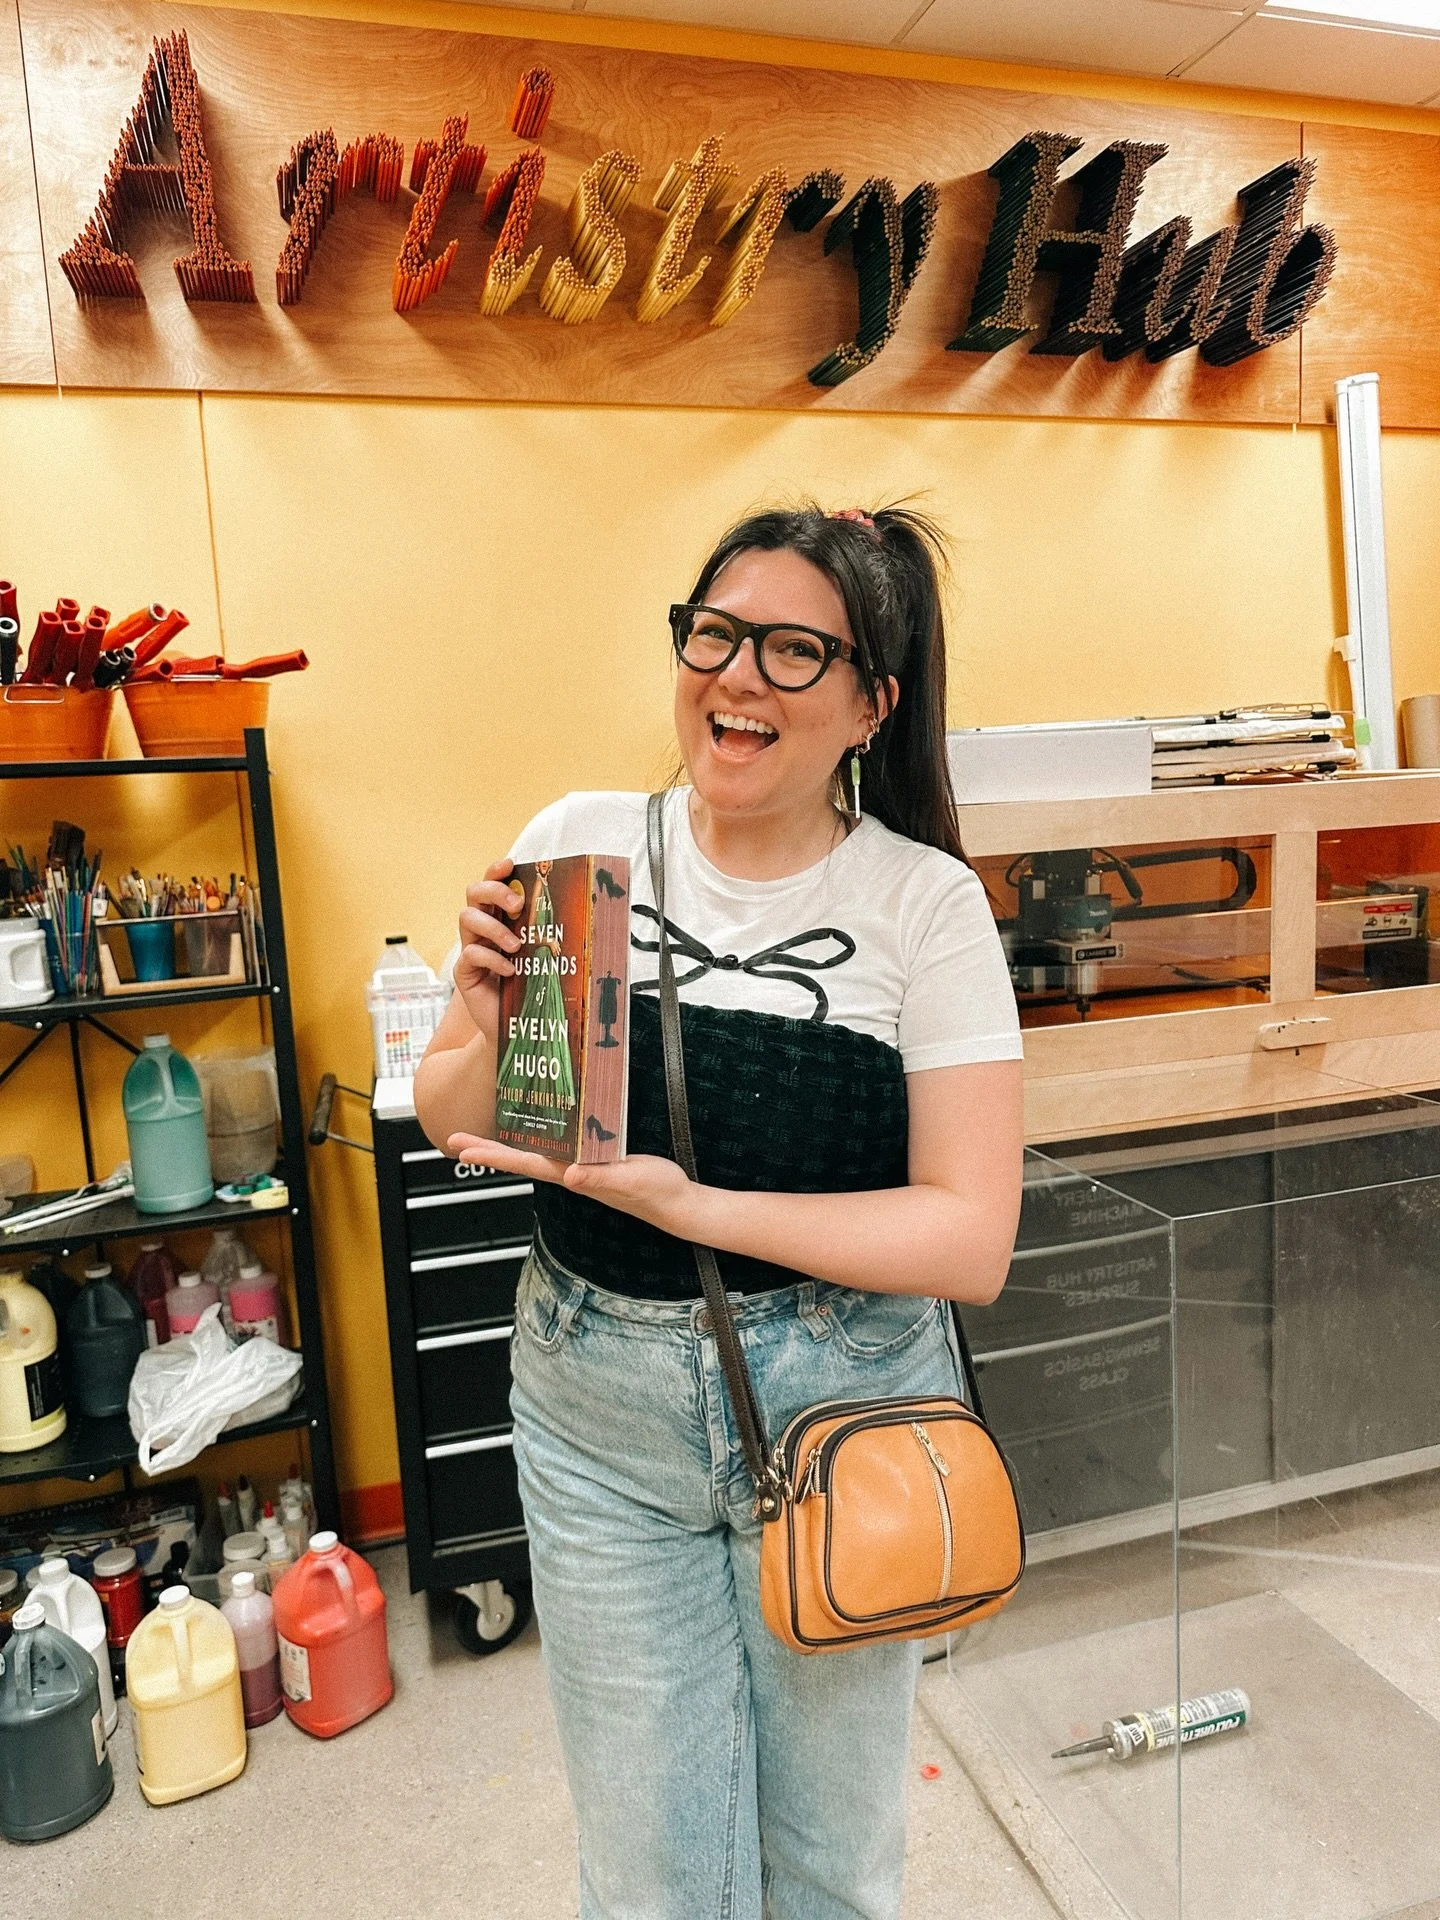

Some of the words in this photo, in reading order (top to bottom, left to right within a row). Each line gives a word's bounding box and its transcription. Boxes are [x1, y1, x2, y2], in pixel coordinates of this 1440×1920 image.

[58, 28, 940, 387] Artistry
[945, 130, 1337, 367] Hub
[535, 895, 552, 912] The
[519, 923, 564, 945] SEVEN
[510, 955, 577, 976] USBANDS
[535, 986, 546, 1006] of
[508, 1017, 569, 1043] EVELYN
[513, 1053, 561, 1080] HUGO
[500, 1086, 523, 1103] TAYLOR
[526, 1090, 554, 1108] JENKINS
